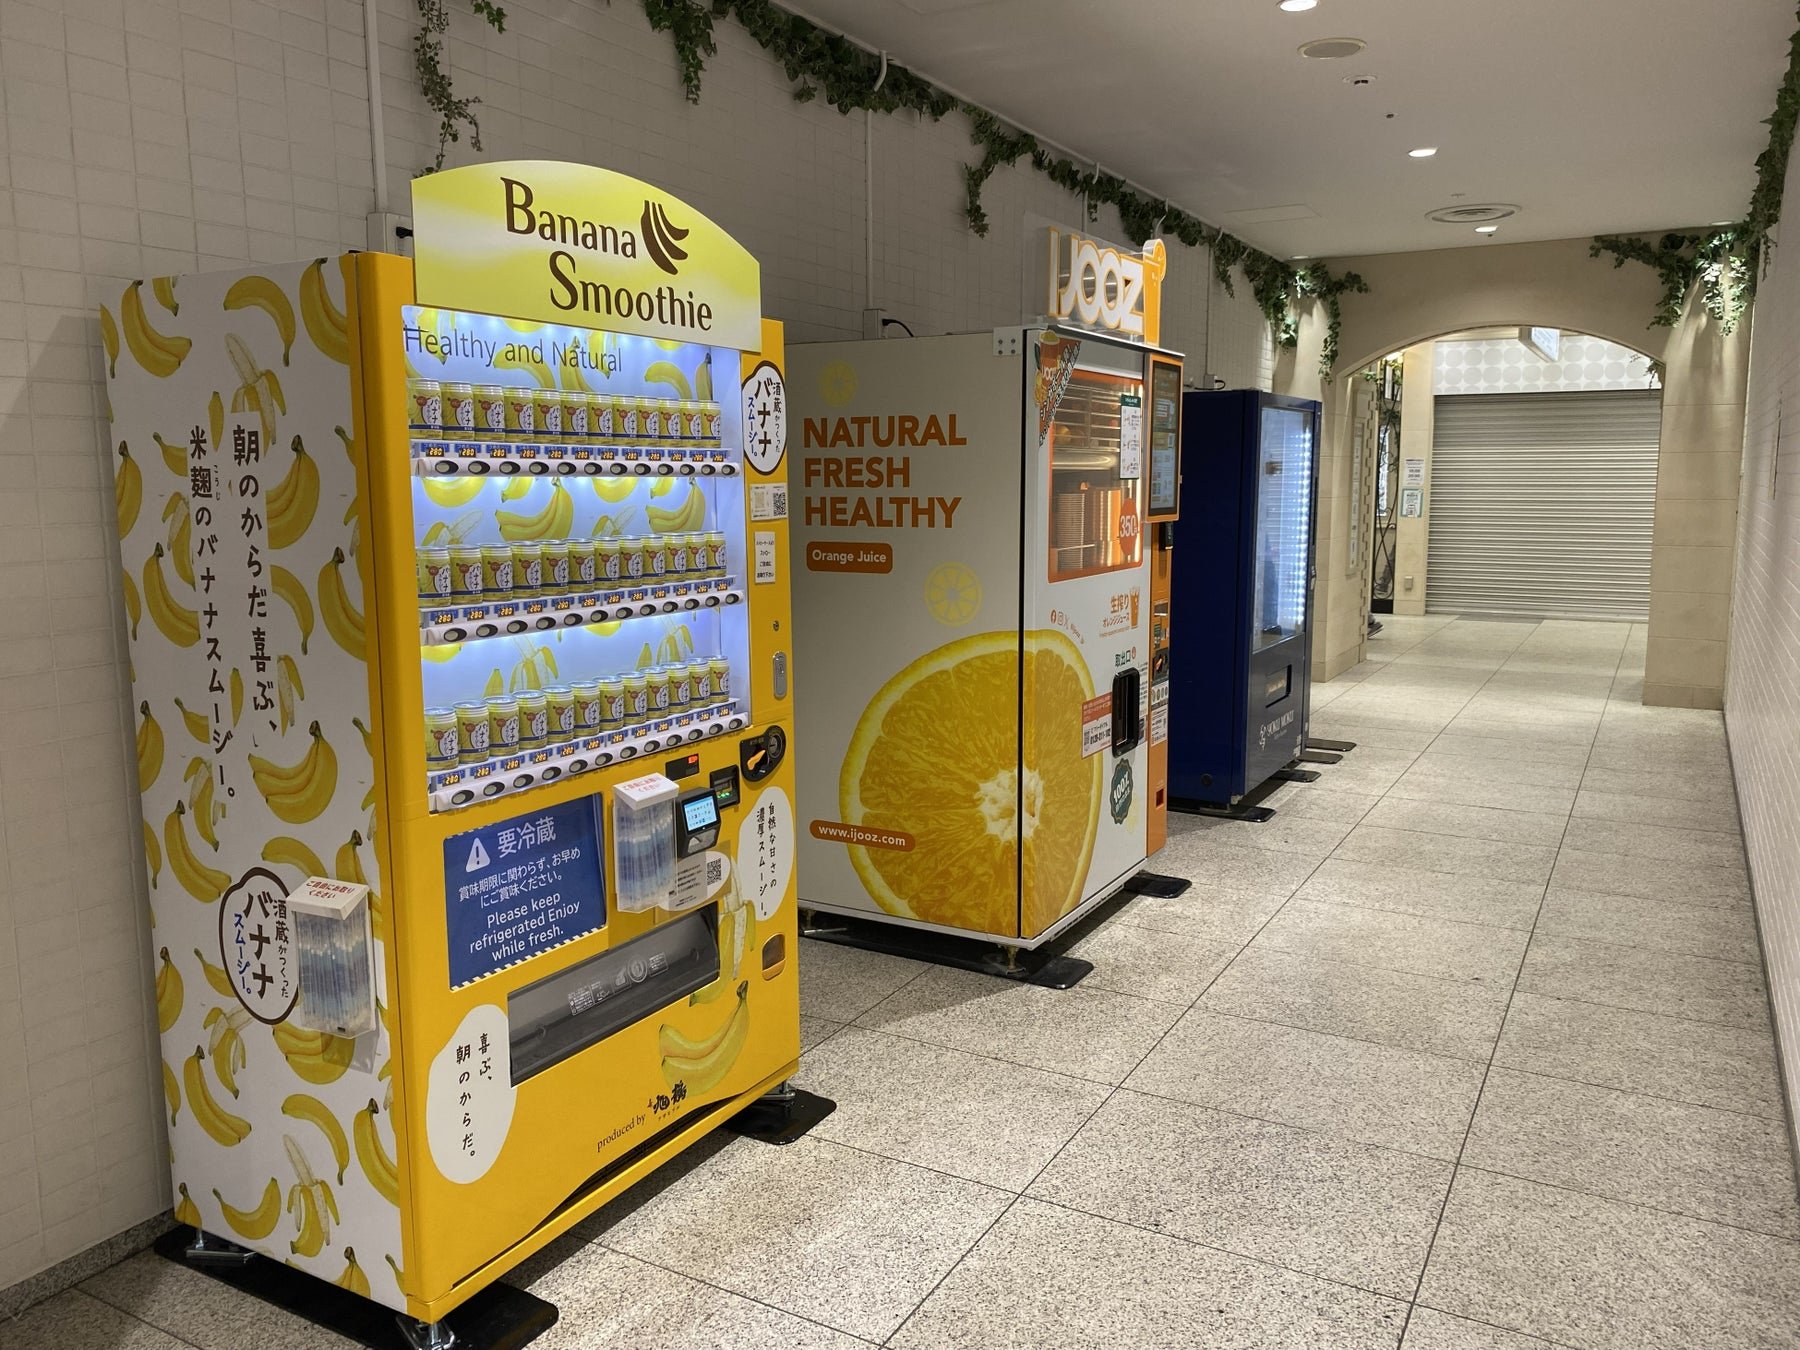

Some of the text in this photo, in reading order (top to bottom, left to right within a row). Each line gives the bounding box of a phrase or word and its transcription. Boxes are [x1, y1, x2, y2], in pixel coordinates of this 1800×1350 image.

[500, 177, 637, 259] Banana
[549, 250, 713, 331] Smoothie
[404, 325, 622, 372] Healthy and Natural
[754, 377, 774, 458] バナナ
[804, 414, 967, 448] NATURAL
[430, 448, 442, 456] 280
[804, 456, 910, 488] FRESH
[805, 496, 962, 528] HEALTHY
[812, 549, 886, 564] Orange Juice
[233, 424, 277, 732] 朝のからだ喜ぶ、
[190, 425, 235, 797] 米麹のバナナスムージー。
[438, 614, 452, 623] 280
[470, 611, 483, 620] 280
[500, 608, 512, 616] 280
[446, 775, 458, 784] 280
[477, 768, 489, 776] 280
[507, 760, 518, 769] 280
[498, 816, 556, 858] 要冷蔵
[818, 826, 906, 846] www.ijooz.com
[458, 848, 580, 902] 賞味期限に関わらず、お早め
[480, 870, 562, 909] にご賞味ください。
[470, 900, 580, 954] refrigerated Enjoy
[487, 892, 561, 929] Please keep
[234, 913, 252, 994] スムージー。
[243, 891, 274, 1000] バナナ
[272, 900, 289, 998] 酒蔵がつくった
[492, 924, 564, 962] while fresh.
[478, 1032, 492, 1081] 喜ぶ、
[456, 1044, 476, 1156] 朝のからだ。
[597, 1114, 646, 1152] produced by
